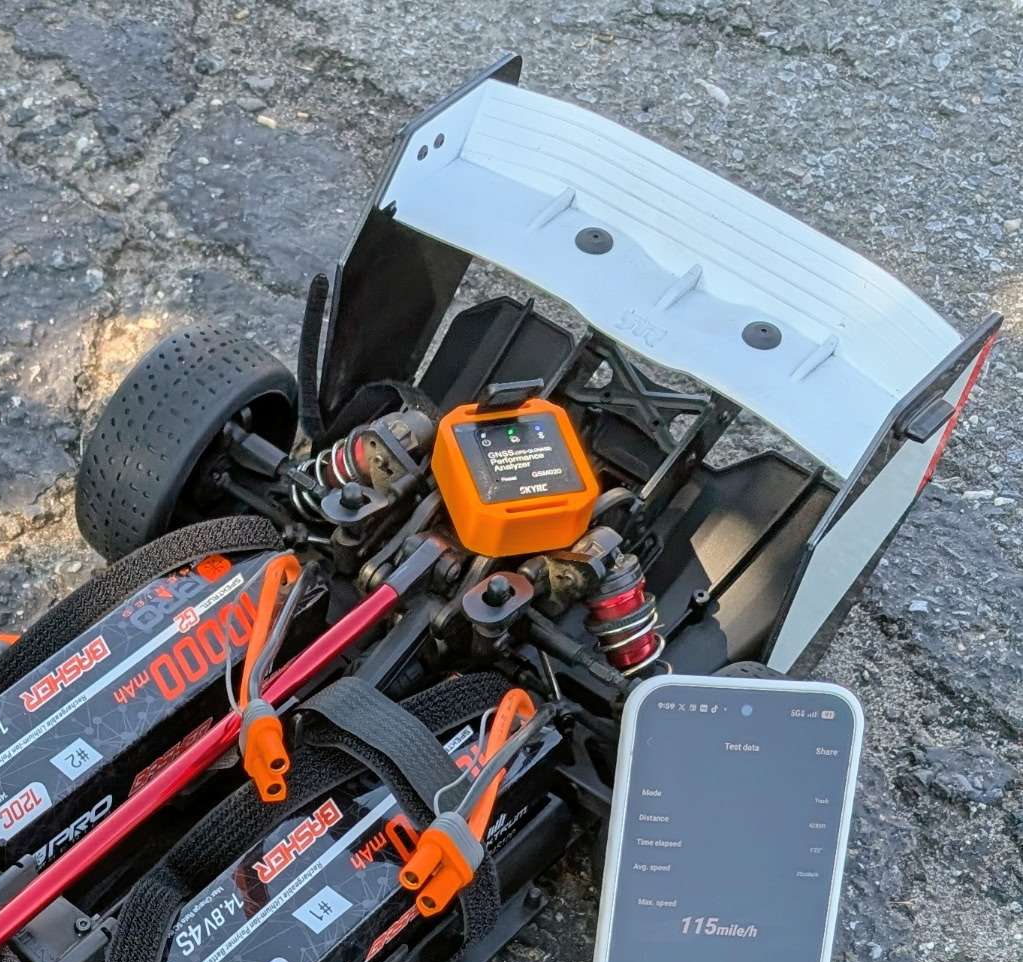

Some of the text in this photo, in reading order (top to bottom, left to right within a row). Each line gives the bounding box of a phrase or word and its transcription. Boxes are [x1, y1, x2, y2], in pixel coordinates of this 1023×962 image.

[487, 449, 514, 459] GNSS
[490, 453, 545, 466] Performance
[494, 461, 531, 472] Analyzer
[519, 483, 548, 495] SKYRC
[173, 611, 198, 633] G2
[19, 636, 110, 712] BASHER
[725, 742, 760, 752] Test data
[816, 747, 838, 756] Share
[65, 749, 89, 768] #2
[642, 788, 662, 797] Mode
[0, 789, 42, 829] 120C
[639, 813, 670, 823] Distance
[252, 798, 343, 884] BASHER
[637, 839, 682, 849] Time elapsed
[650, 864, 671, 873] speed
[281, 862, 322, 897] Rechargeable
[309, 900, 334, 922] #1
[175, 892, 243, 956] 14.8V 4S
[224, 926, 250, 950] Polymer
